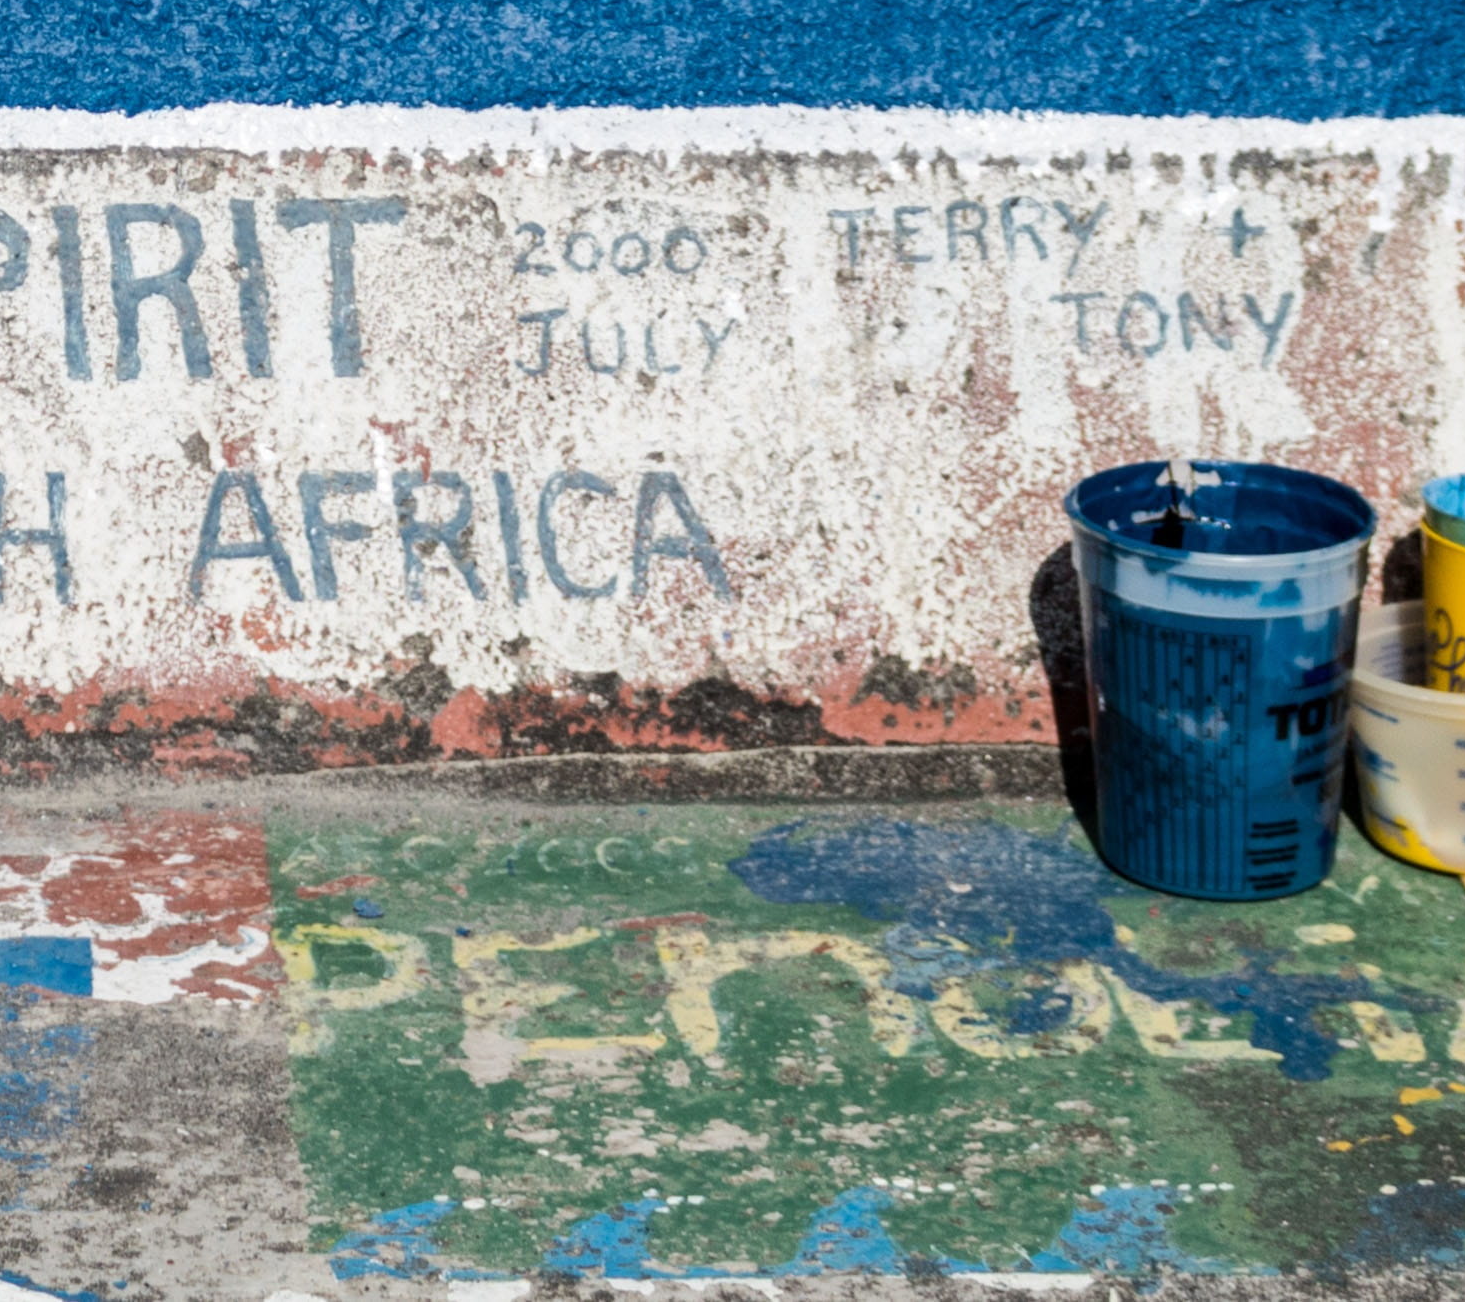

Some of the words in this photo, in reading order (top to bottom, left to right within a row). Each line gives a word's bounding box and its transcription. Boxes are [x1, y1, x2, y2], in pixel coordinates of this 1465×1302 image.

[514, 223, 708, 277] 2000
[829, 198, 1111, 278] TERRY
[514, 305, 742, 379] JULY
[1049, 288, 1296, 368] TONY
[188, 469, 740, 603] AFRICA
